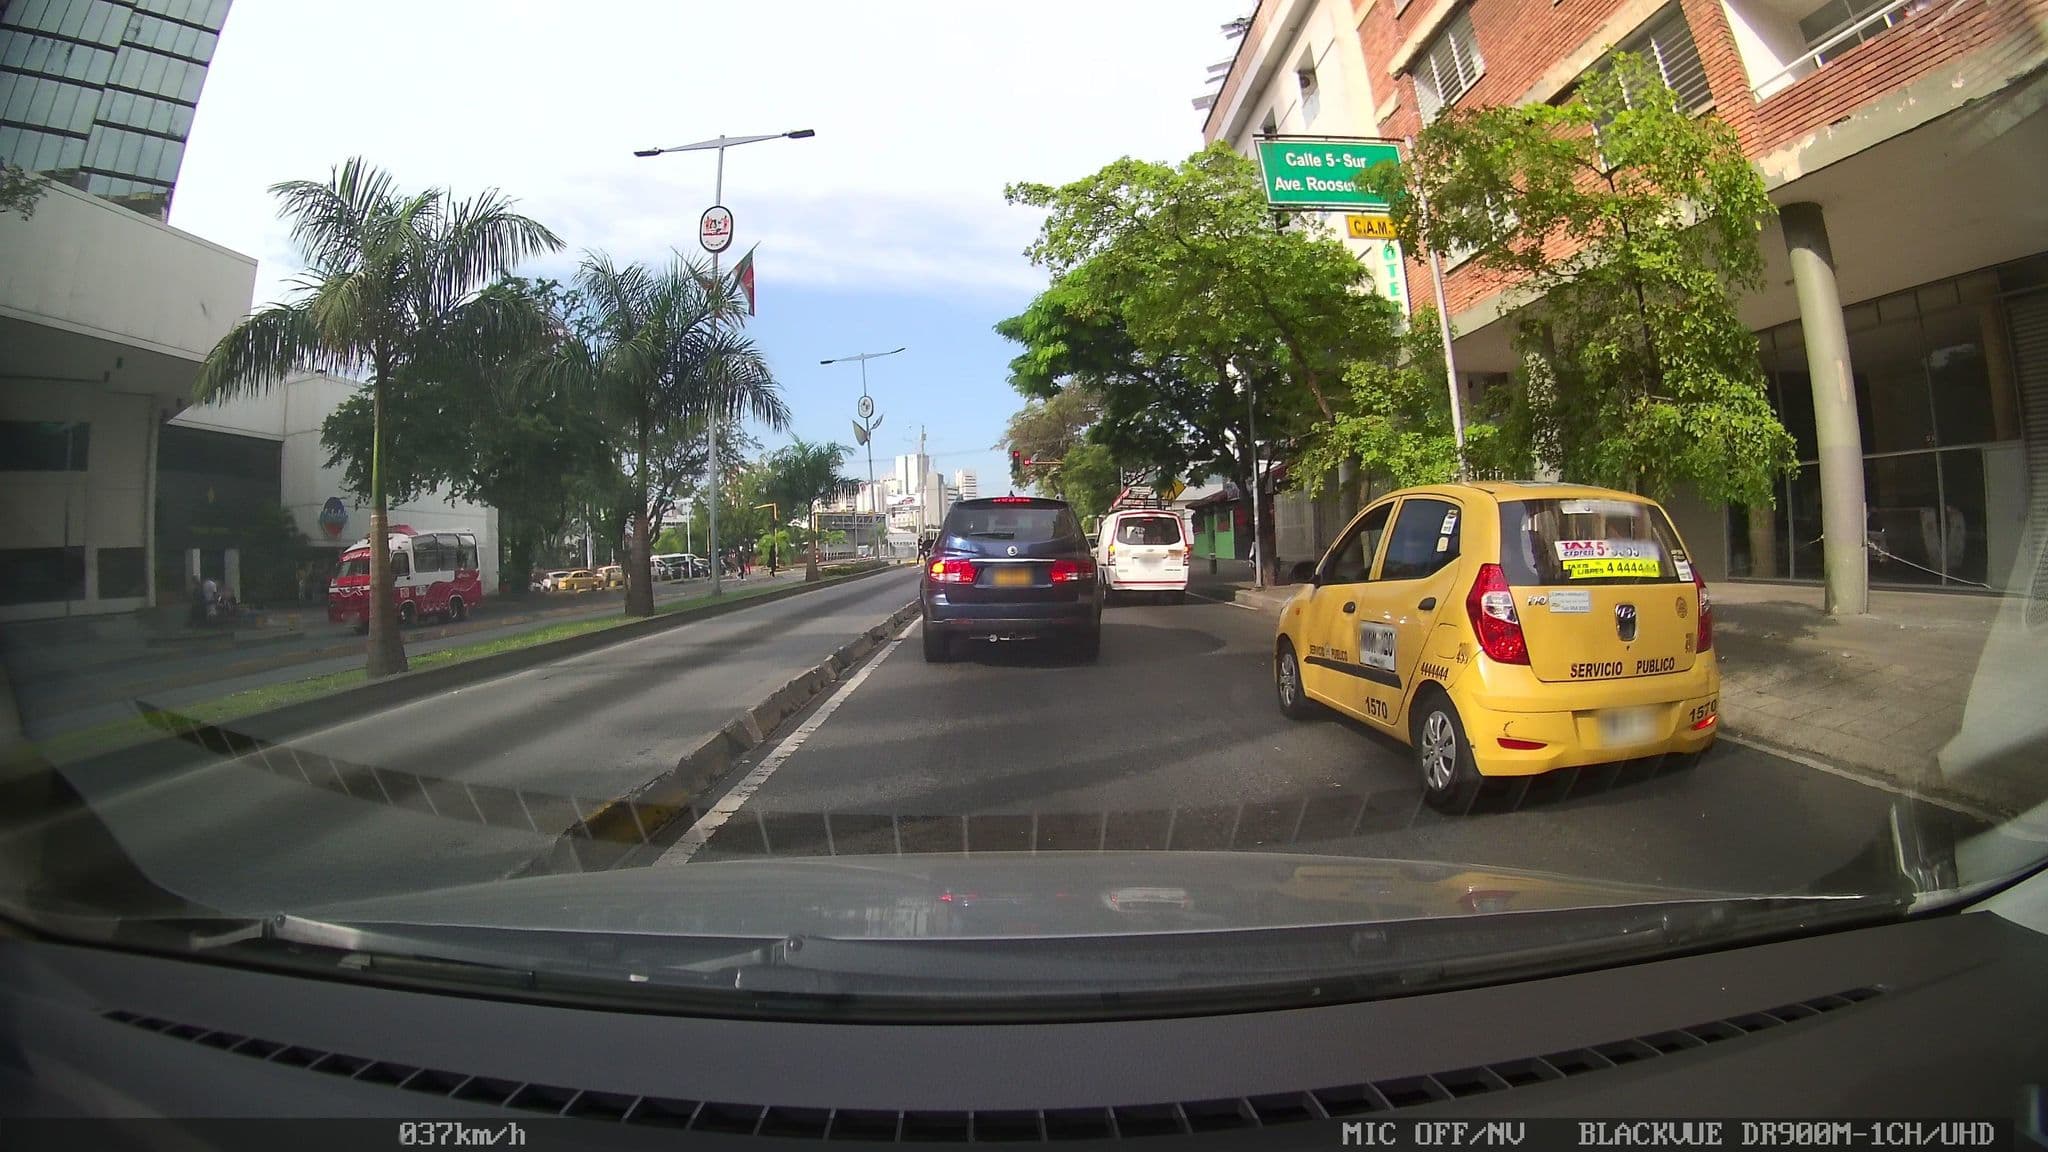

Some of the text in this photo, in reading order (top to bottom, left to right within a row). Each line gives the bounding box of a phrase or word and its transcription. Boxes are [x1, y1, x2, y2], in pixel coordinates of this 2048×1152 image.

[1285, 152, 1322, 167] Calle
[1275, 176, 1377, 193] Ave. Roose
[1383, 243, 1401, 314] OTE
[1570, 657, 1675, 678] SERVICIO PUBLICO
[1365, 696, 1388, 719] 1570
[1689, 700, 1717, 722] 1570
